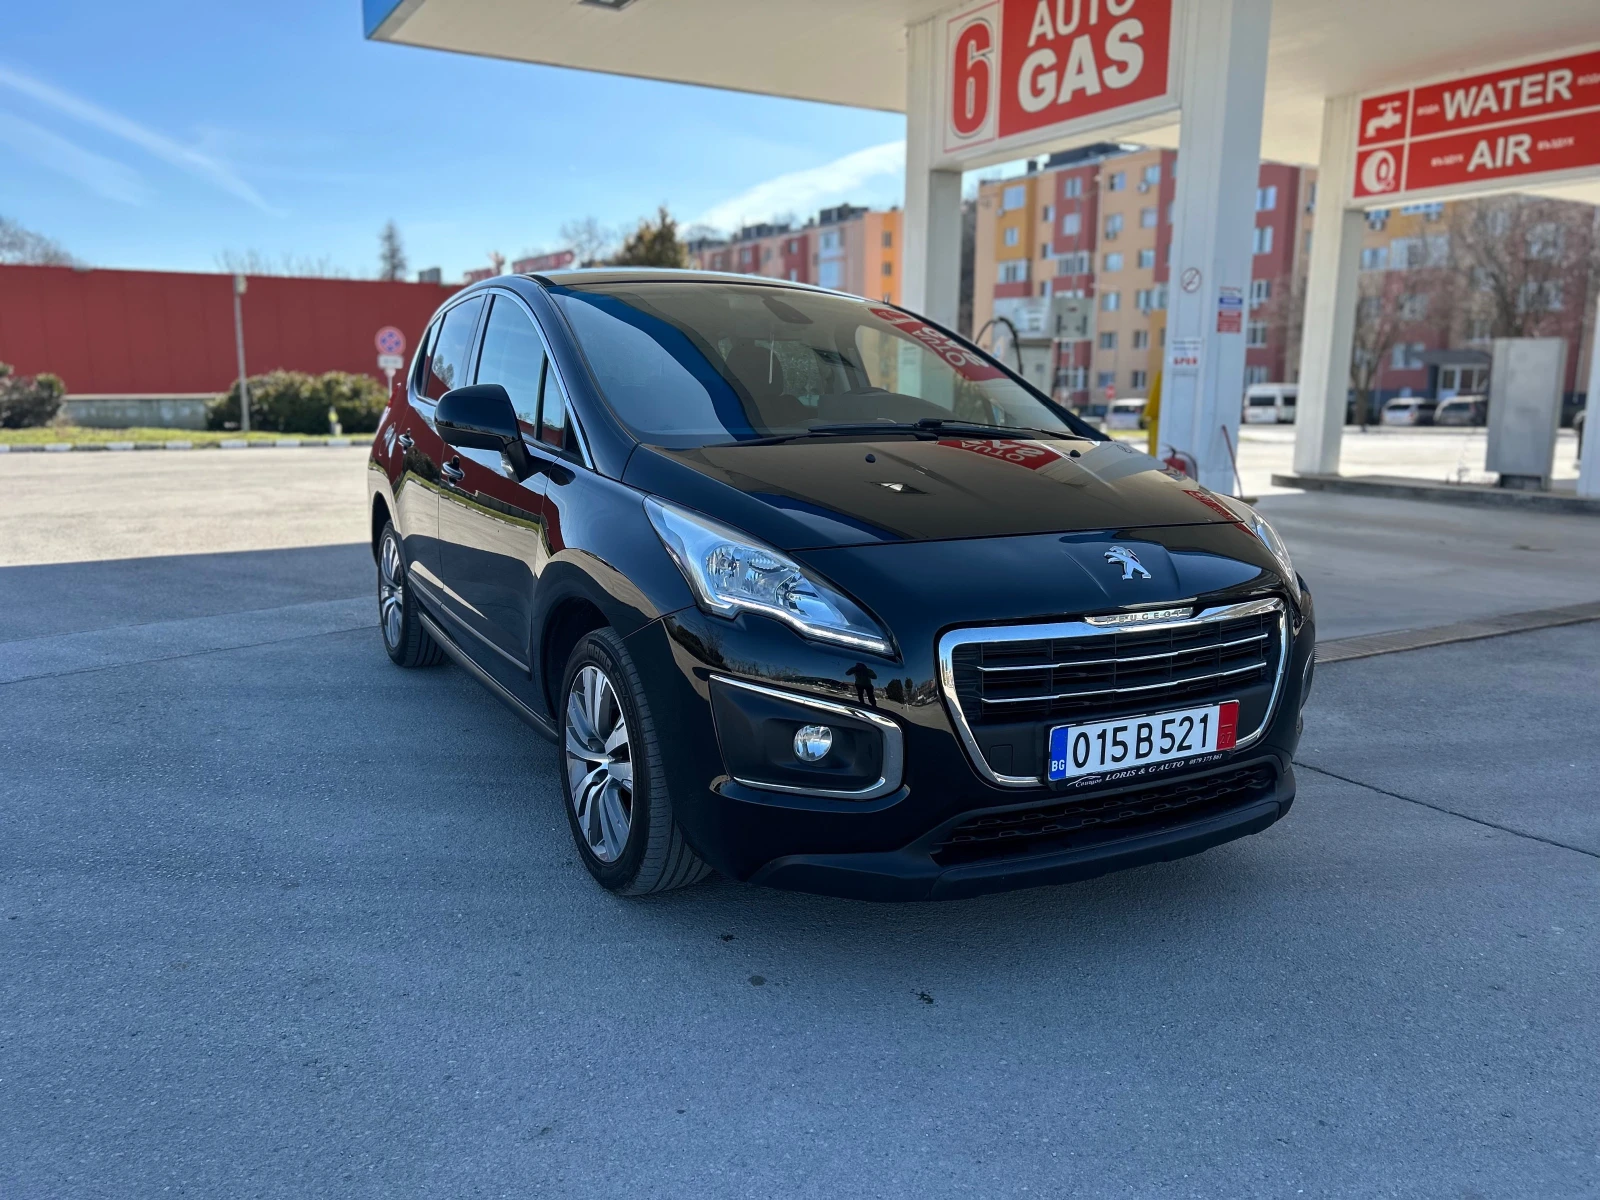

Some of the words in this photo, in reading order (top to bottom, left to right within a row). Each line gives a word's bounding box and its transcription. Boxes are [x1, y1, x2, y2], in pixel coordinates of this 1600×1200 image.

[950, 18, 994, 139] 6
[1018, 18, 1144, 113] GAS
[1442, 68, 1573, 121] WATER
[1466, 133, 1532, 173] AIR
[1051, 760, 1066, 772] BG
[1072, 713, 1209, 768] 015B521
[1105, 767, 1137, 781] LORIS
[1138, 767, 1146, 775] &
[1148, 765, 1157, 773] G
[1157, 760, 1185, 771] AUTO
